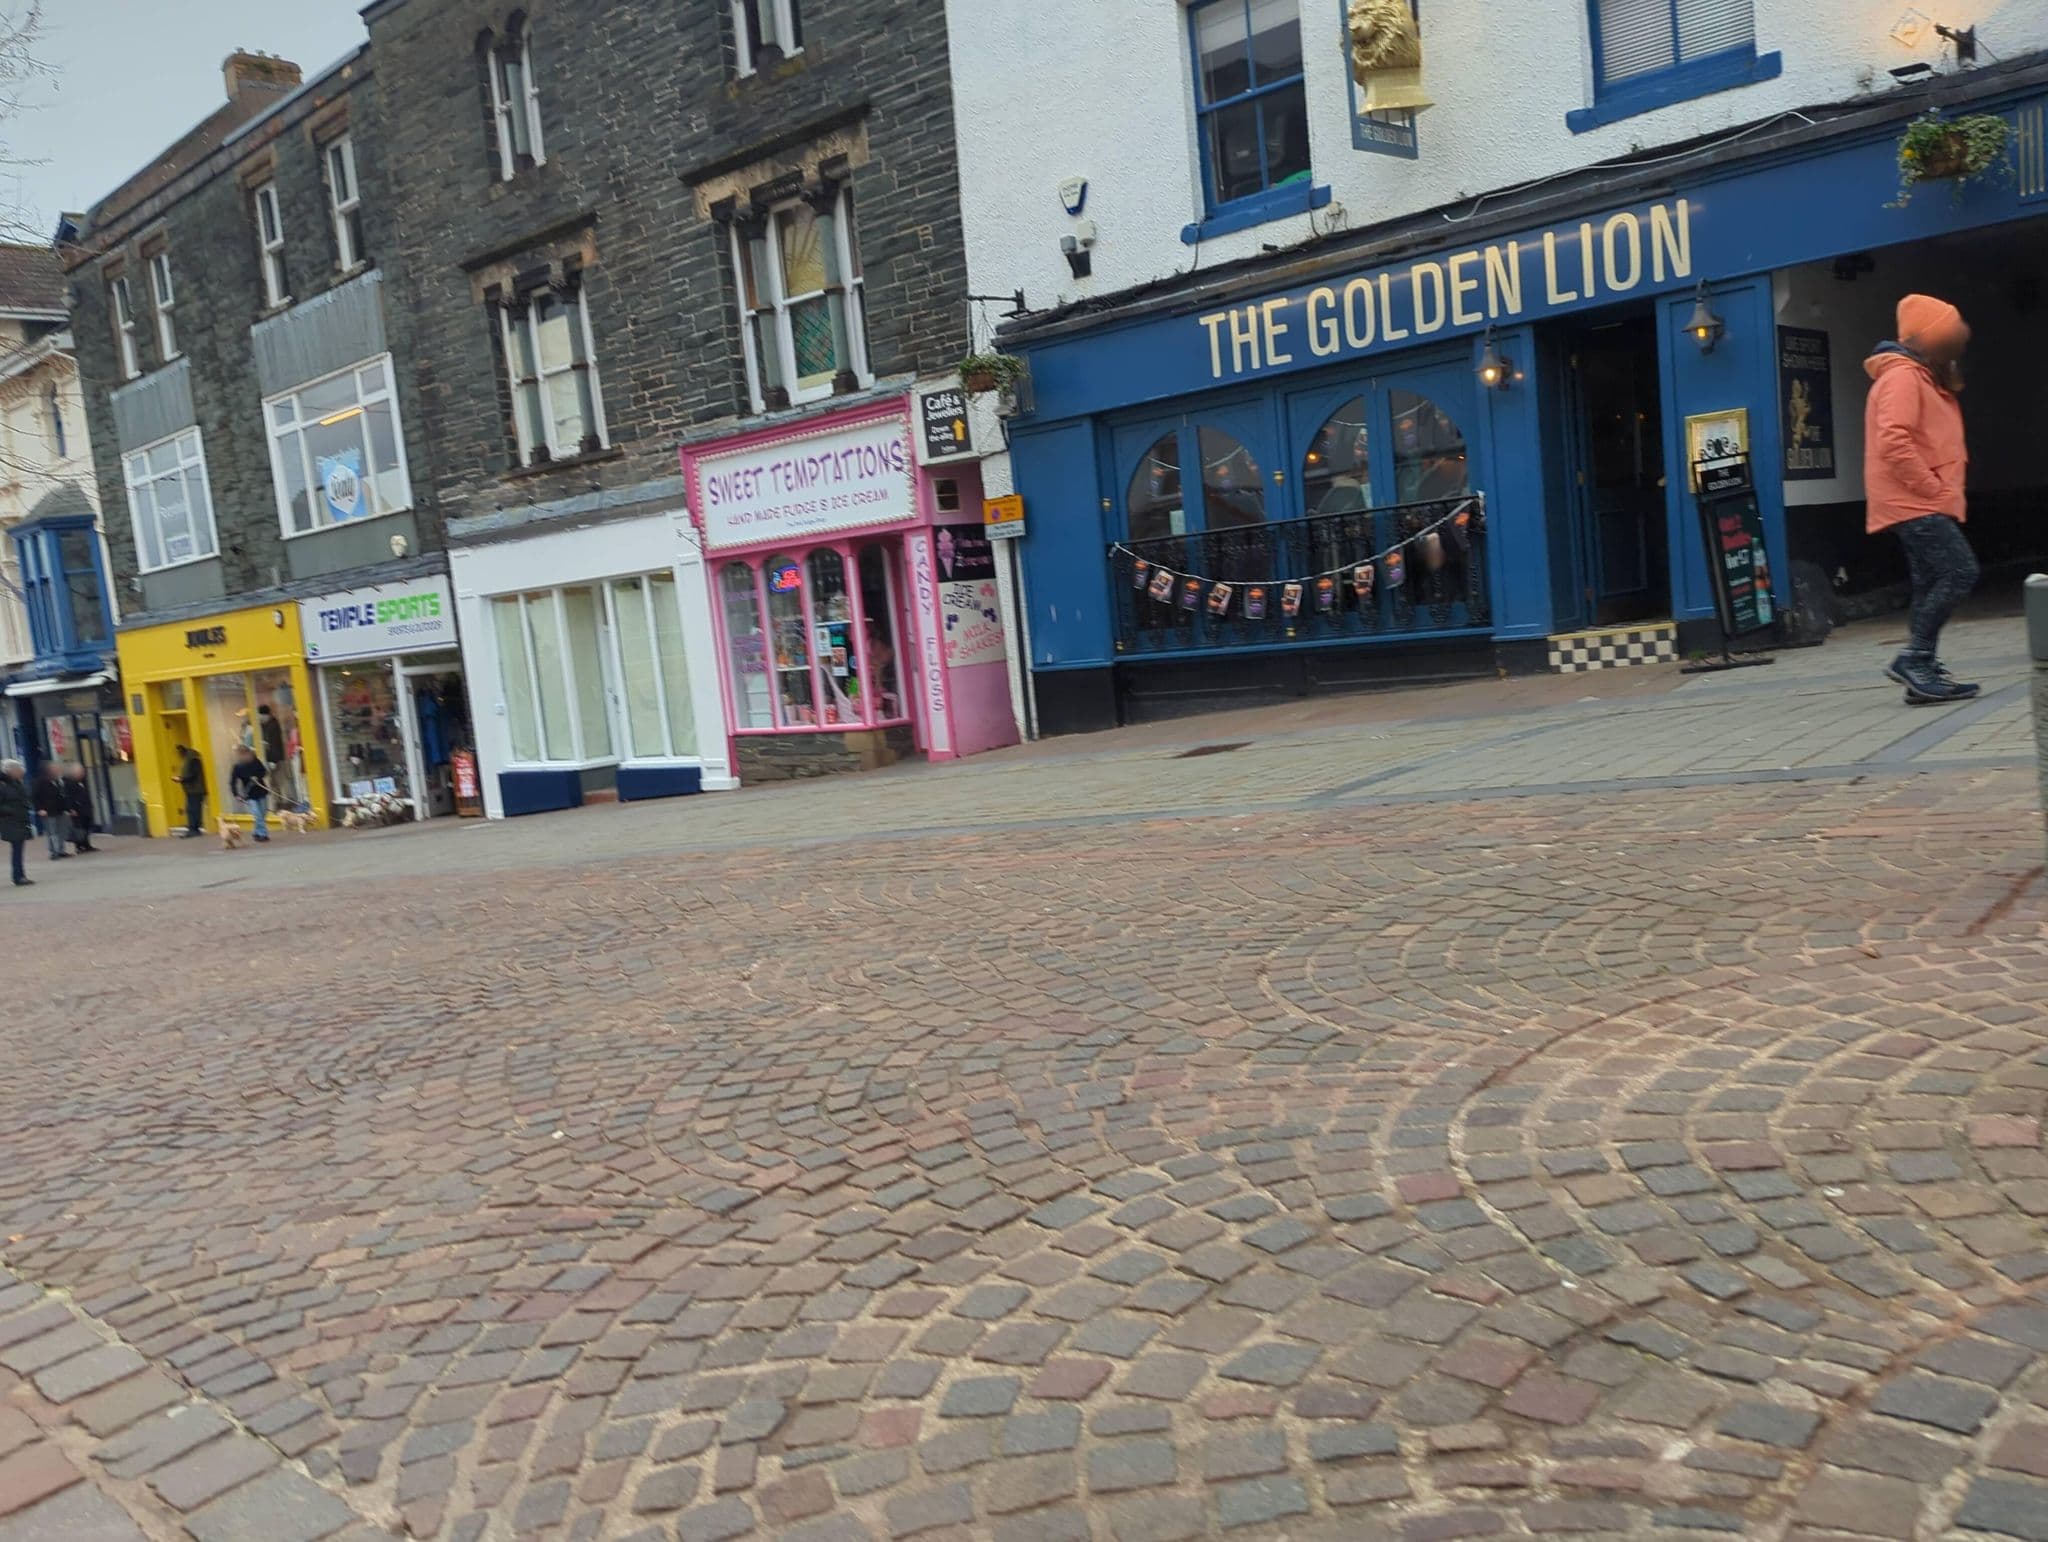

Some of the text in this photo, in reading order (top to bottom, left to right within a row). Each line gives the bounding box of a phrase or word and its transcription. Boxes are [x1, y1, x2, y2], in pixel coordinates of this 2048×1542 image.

[1199, 198, 1692, 378] THE GOLDEN LION
[926, 393, 961, 410] Café &
[708, 440, 904, 506] SWEET TEMPTATIONS
[727, 512, 753, 527] HAND
[754, 507, 780, 522] MADE
[783, 501, 817, 518] FUDGE
[831, 494, 850, 510] ICE
[852, 488, 890, 506] CREAM
[943, 594, 981, 611] CREAM
[953, 583, 974, 598] ICE
[319, 603, 375, 632] TEMPLE
[377, 592, 440, 623] SPORTS
[964, 623, 991, 640] MILK
[926, 636, 945, 713] FLOSS
